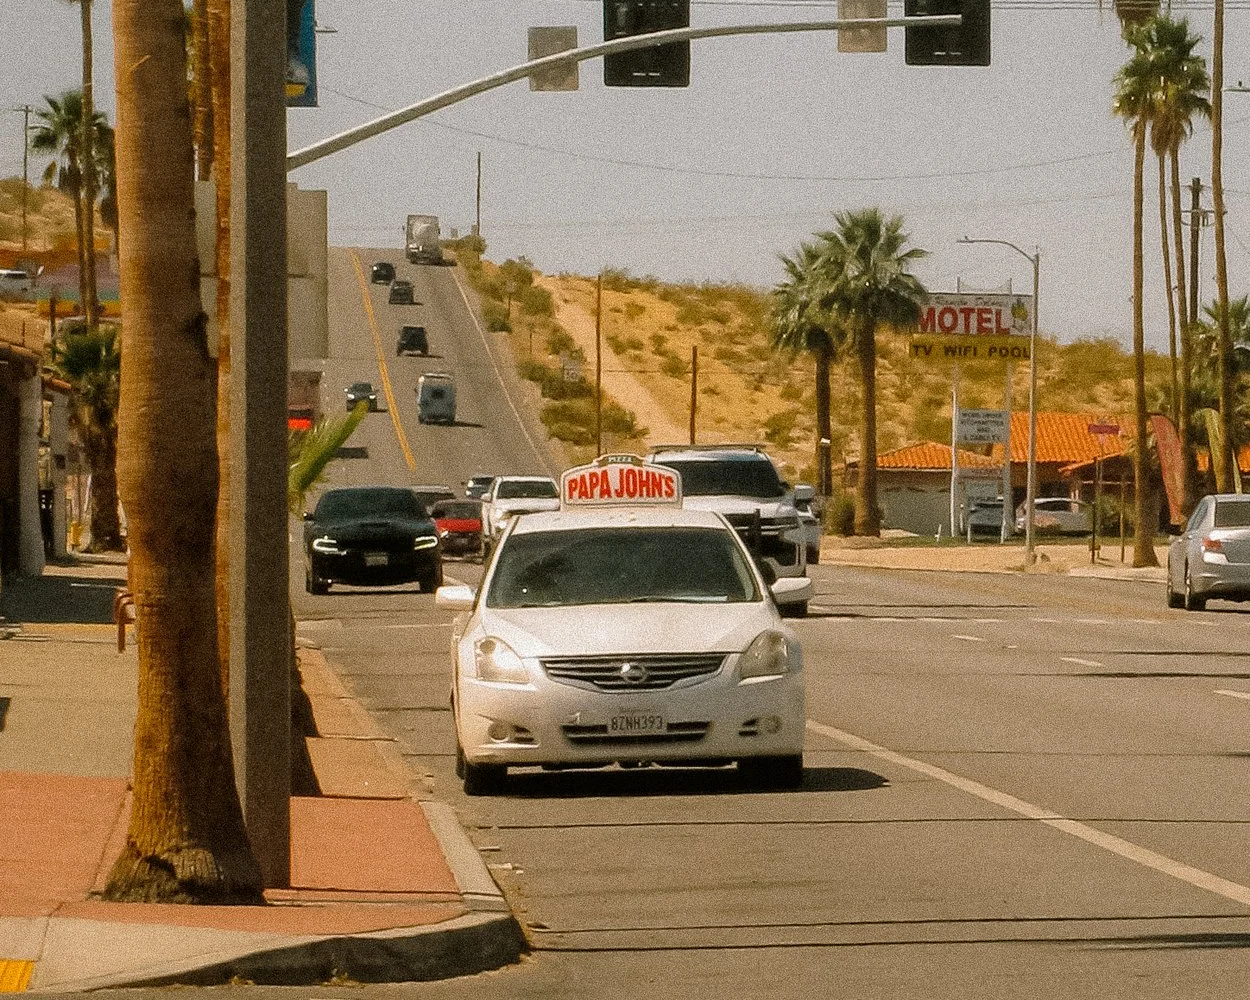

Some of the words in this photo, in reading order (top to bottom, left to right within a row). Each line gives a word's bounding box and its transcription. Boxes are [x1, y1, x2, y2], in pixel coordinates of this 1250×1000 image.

[919, 306, 1010, 335] MOTEL
[912, 344, 933, 356] TV
[943, 345, 977, 357] WIFI
[988, 346, 1031, 359] POOL
[568, 469, 612, 499] PAPA
[615, 468, 674, 498] JOHN'S
